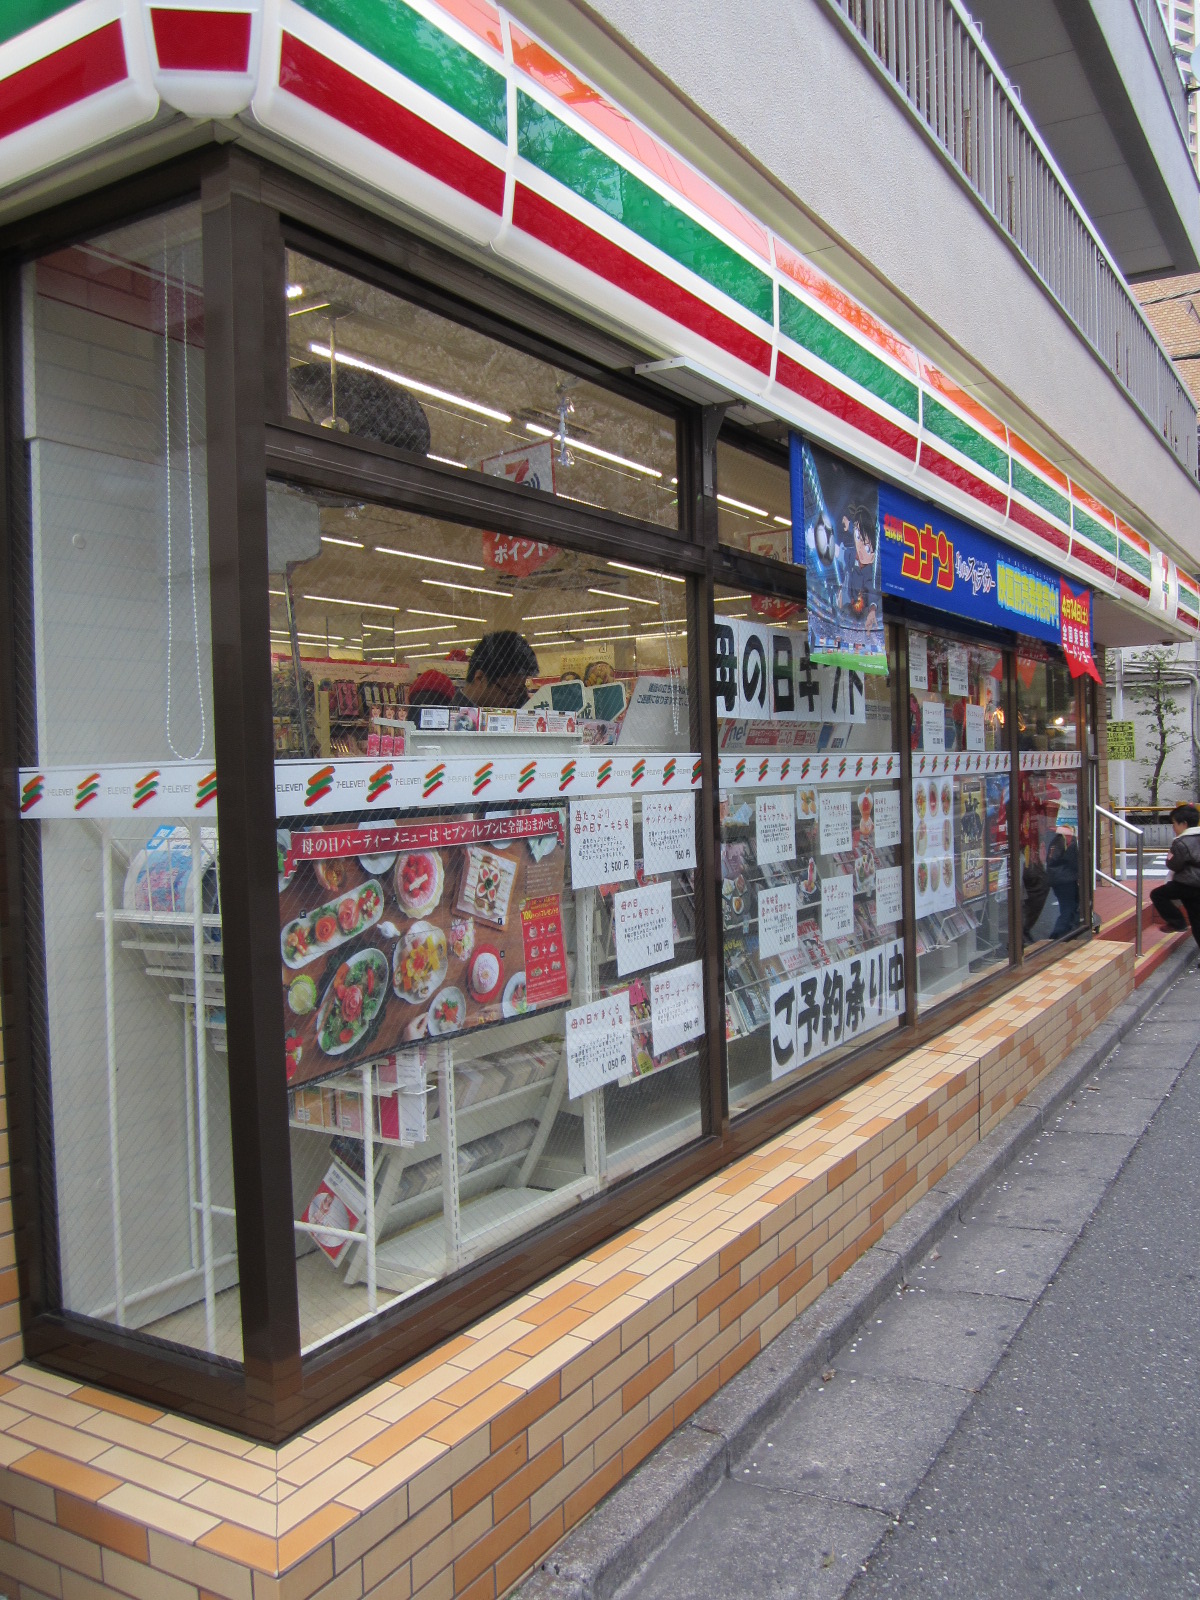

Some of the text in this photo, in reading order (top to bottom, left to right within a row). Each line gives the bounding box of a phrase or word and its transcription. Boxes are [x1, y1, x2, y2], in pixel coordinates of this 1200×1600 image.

[494, 541, 549, 564] ポイント
[901, 521, 954, 591] コナン
[162, 784, 192, 793] 7-ELEVEN
[336, 779, 366, 789] 7-ELEVEN
[394, 777, 421, 786] 7-ELEVEN
[301, 829, 439, 855] 母の日パーティーメニューは
[620, 898, 638, 910] 母の日
[772, 943, 905, 1066] ご予約承り中
